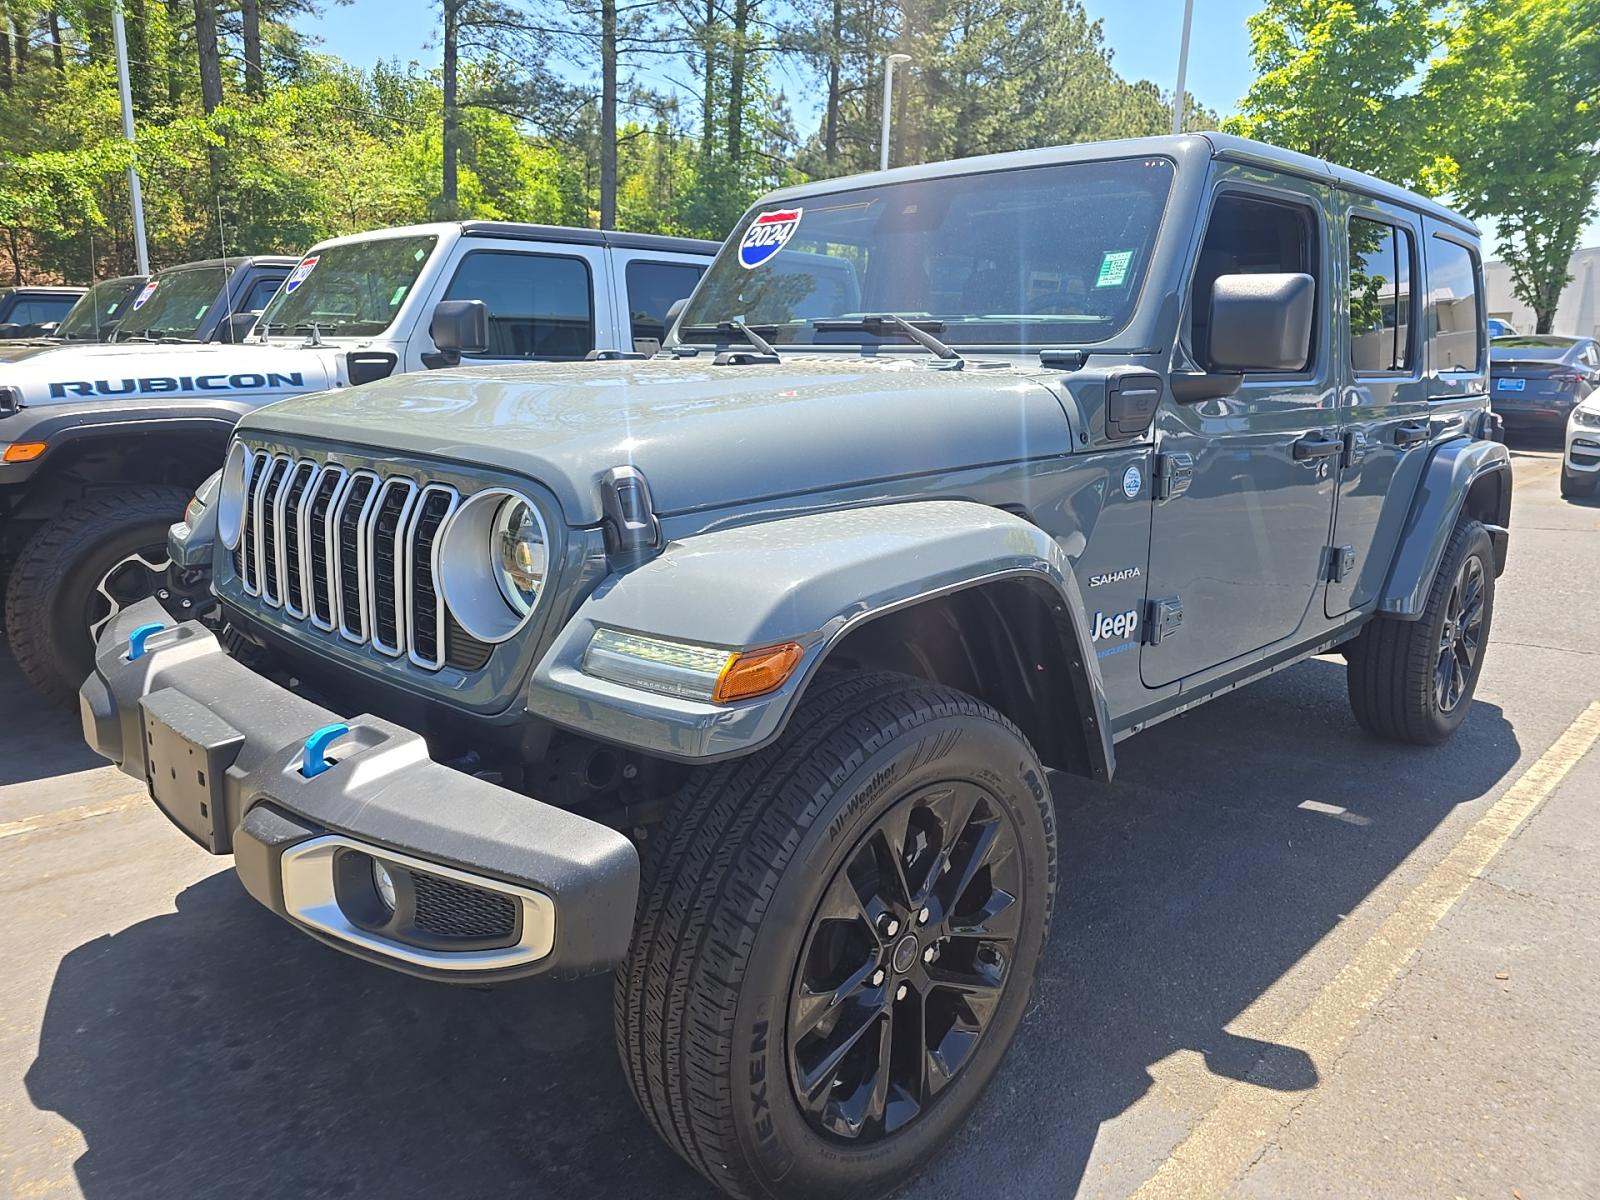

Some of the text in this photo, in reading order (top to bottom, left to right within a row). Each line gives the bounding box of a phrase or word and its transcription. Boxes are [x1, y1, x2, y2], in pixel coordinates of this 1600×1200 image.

[744, 223, 793, 248] 2024
[49, 372, 304, 398] RUBICON
[1089, 567, 1141, 588] SAHARA
[1090, 610, 1138, 643] Jeep
